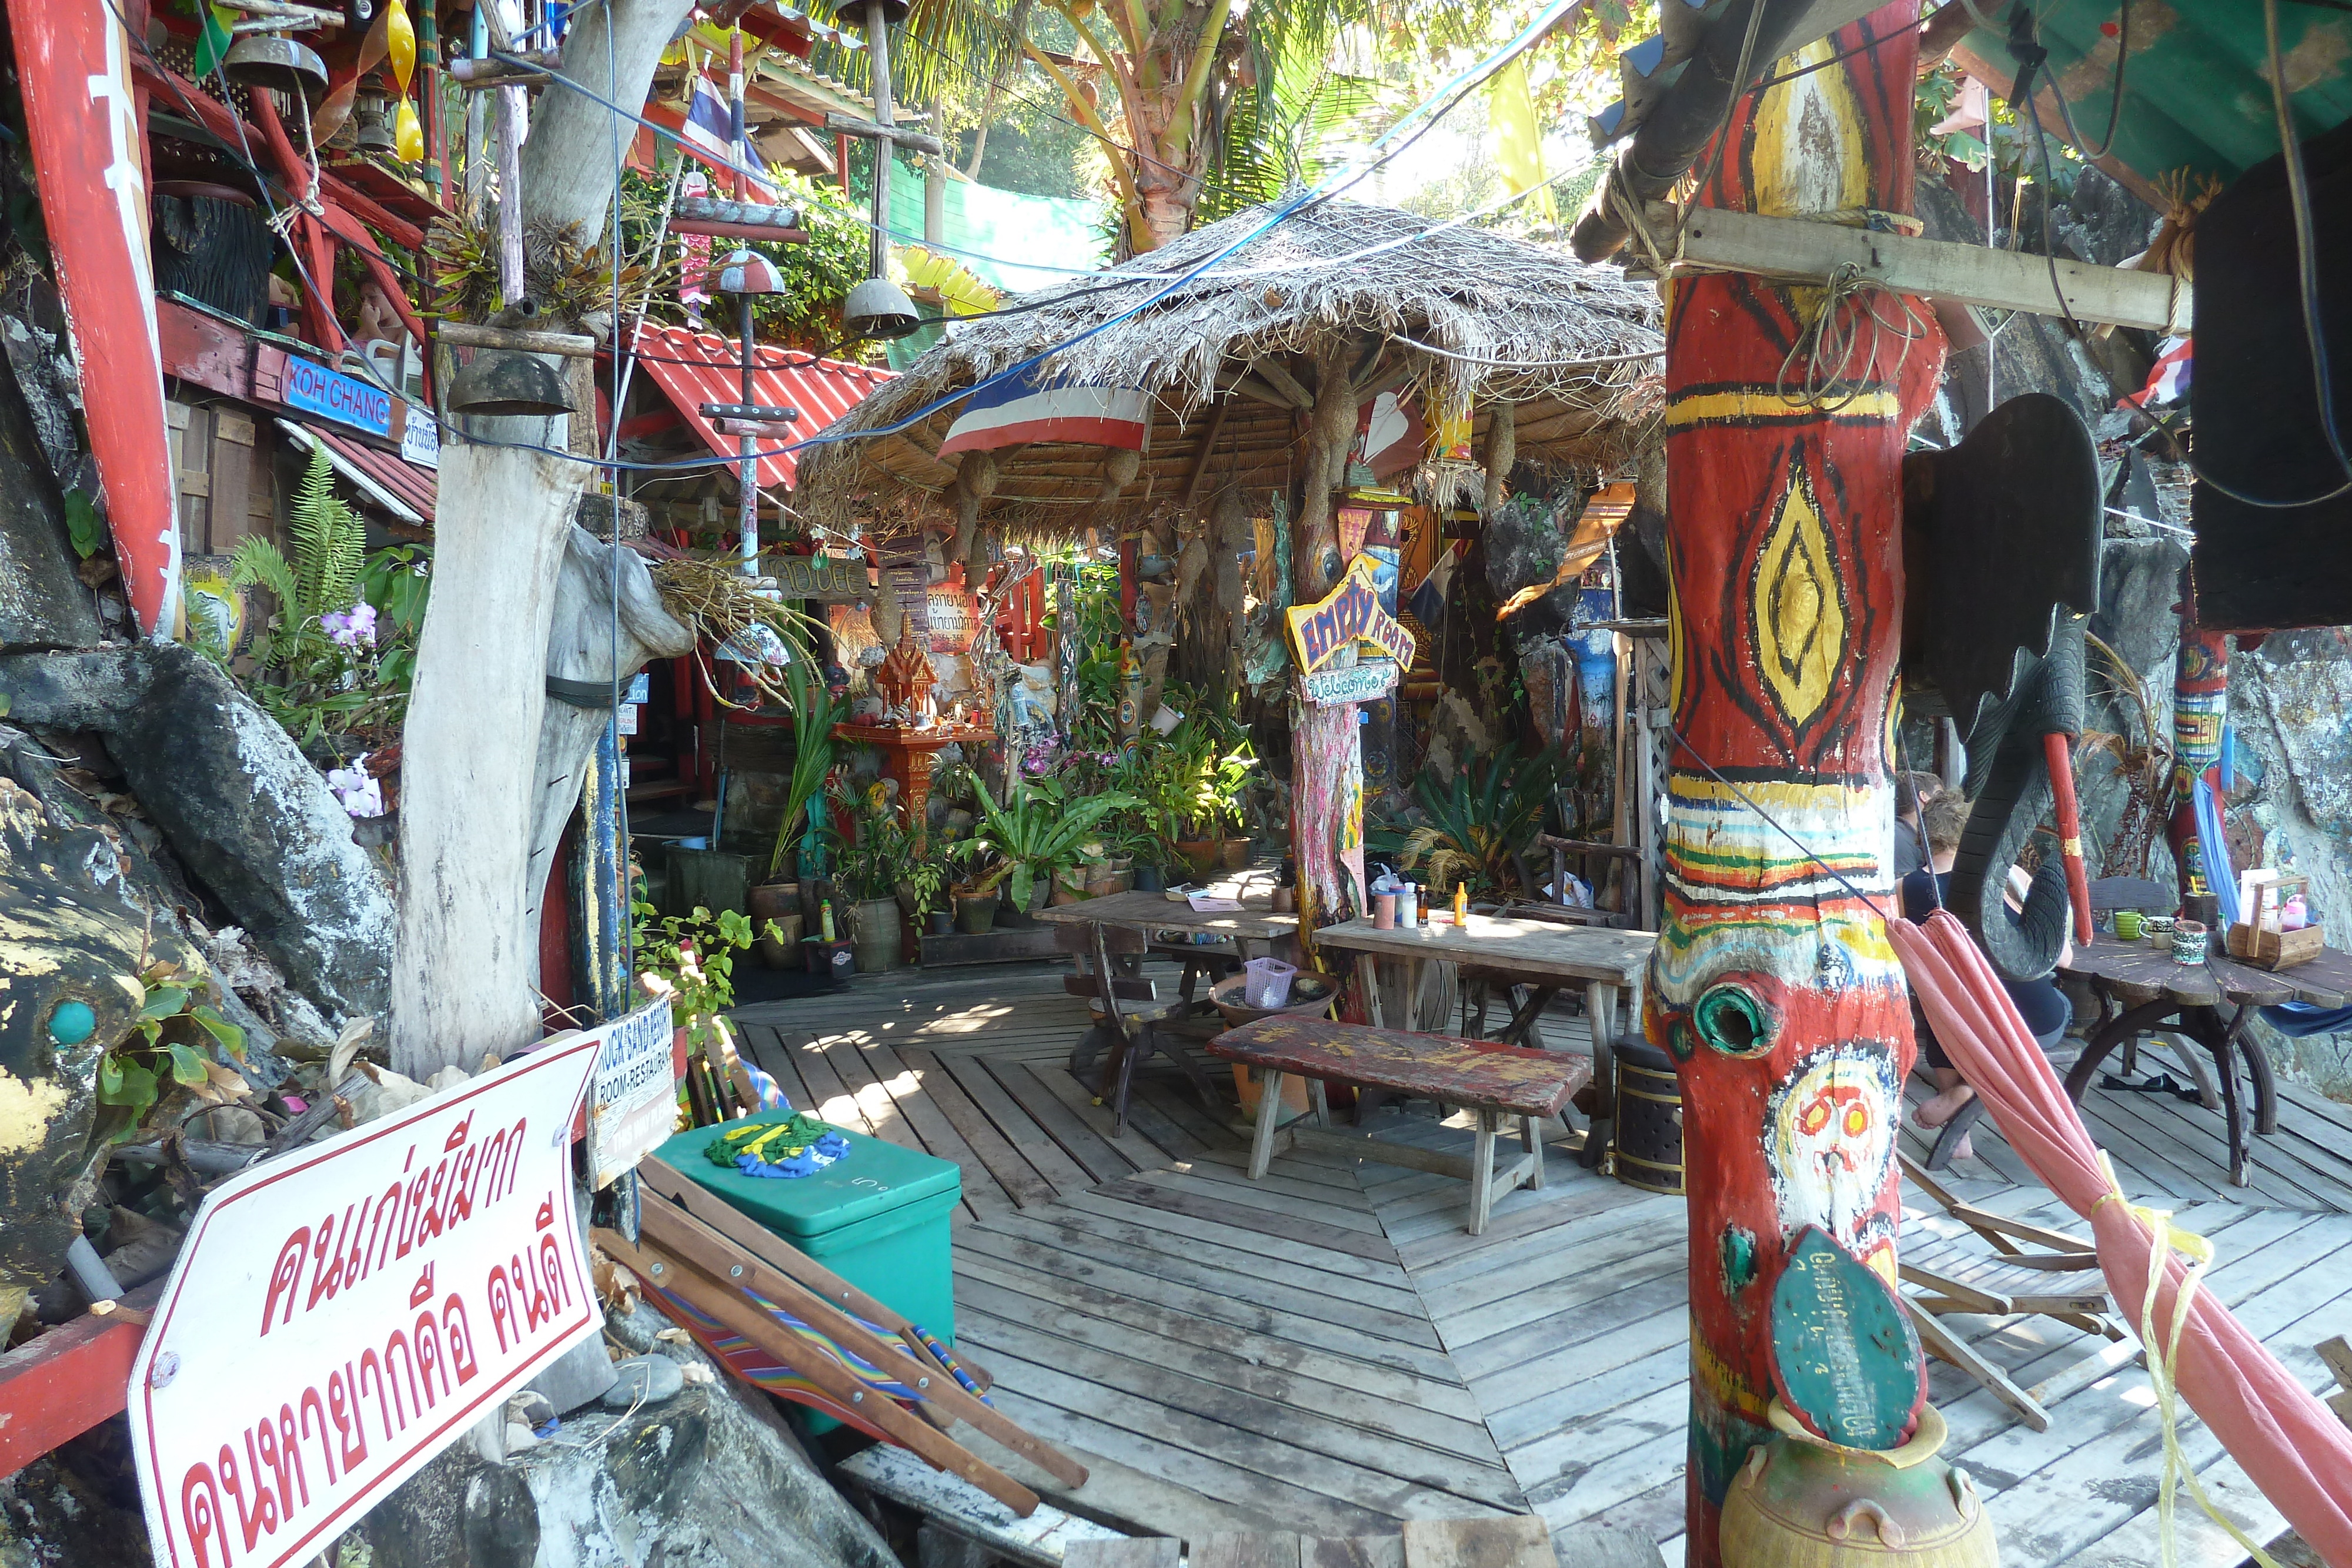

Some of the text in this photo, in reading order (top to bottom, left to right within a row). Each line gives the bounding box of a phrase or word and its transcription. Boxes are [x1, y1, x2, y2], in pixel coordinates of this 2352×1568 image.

[290, 363, 386, 424] KOH CHANG
[1301, 575, 1414, 668] EMPTY ROOM
[1308, 674, 1379, 700] Welcome
[627, 1015, 648, 1060] SAND
[650, 999, 670, 1048] RESORT
[600, 1042, 671, 1105] ROOM-RESTAURANT
[612, 1124, 633, 1154] THIS
[634, 1112, 650, 1139] WAY
[260, 1108, 527, 1338] คนเก่งมีมาก
[487, 1190, 572, 1355] คนดี
